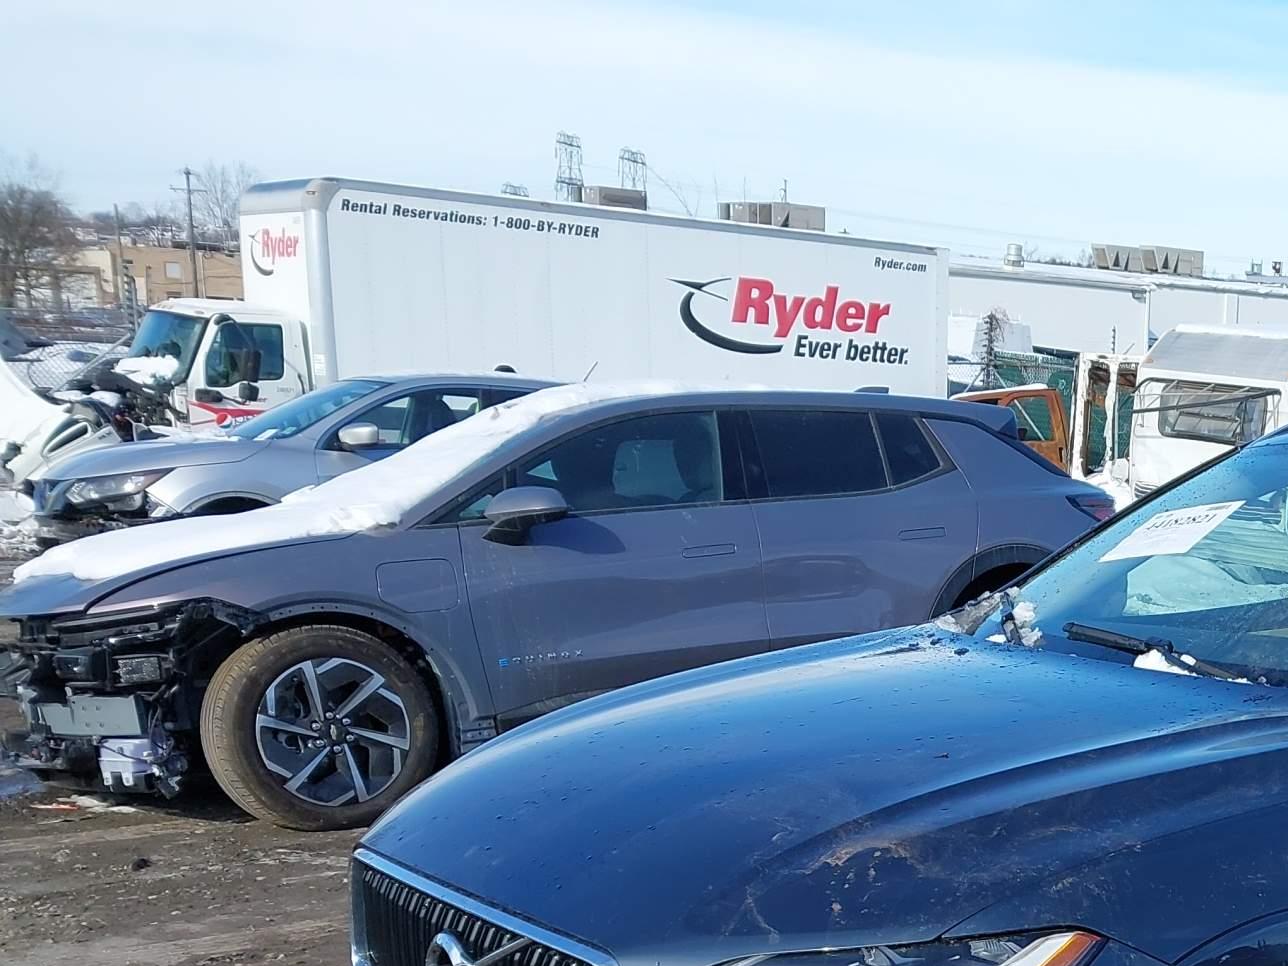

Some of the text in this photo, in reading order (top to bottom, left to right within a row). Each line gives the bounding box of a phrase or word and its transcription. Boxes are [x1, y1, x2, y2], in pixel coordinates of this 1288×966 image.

[341, 199, 600, 239] Rental Reservations: 1-800-BY-RYDER
[261, 227, 299, 265] Ryder
[874, 257, 927, 272] Ryder.com
[731, 277, 891, 338] Ryder
[793, 335, 909, 365] Ever better.
